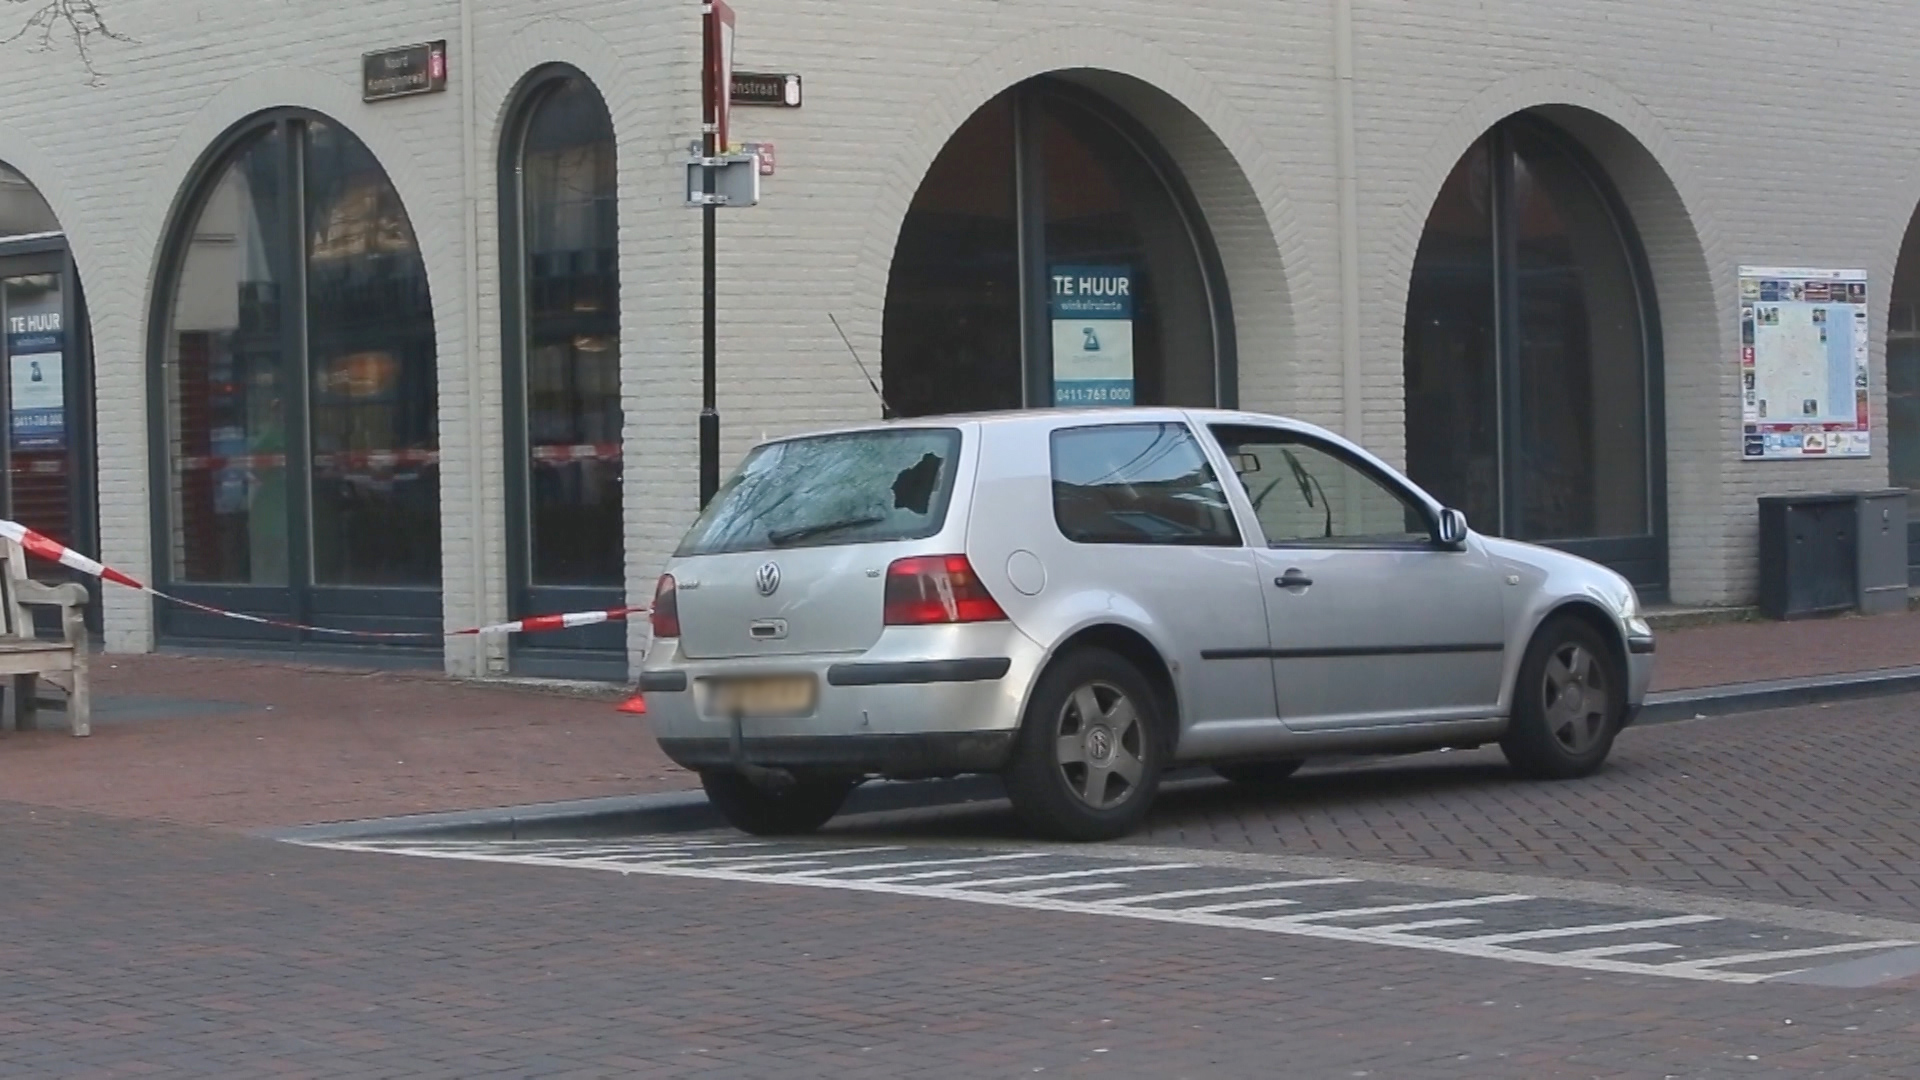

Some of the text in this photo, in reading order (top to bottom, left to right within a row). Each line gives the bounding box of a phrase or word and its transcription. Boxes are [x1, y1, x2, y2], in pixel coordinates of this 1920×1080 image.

[730, 81, 779, 96] enstraat
[1053, 276, 1130, 296] TE HUUR
[10, 313, 60, 333] TE HUUR
